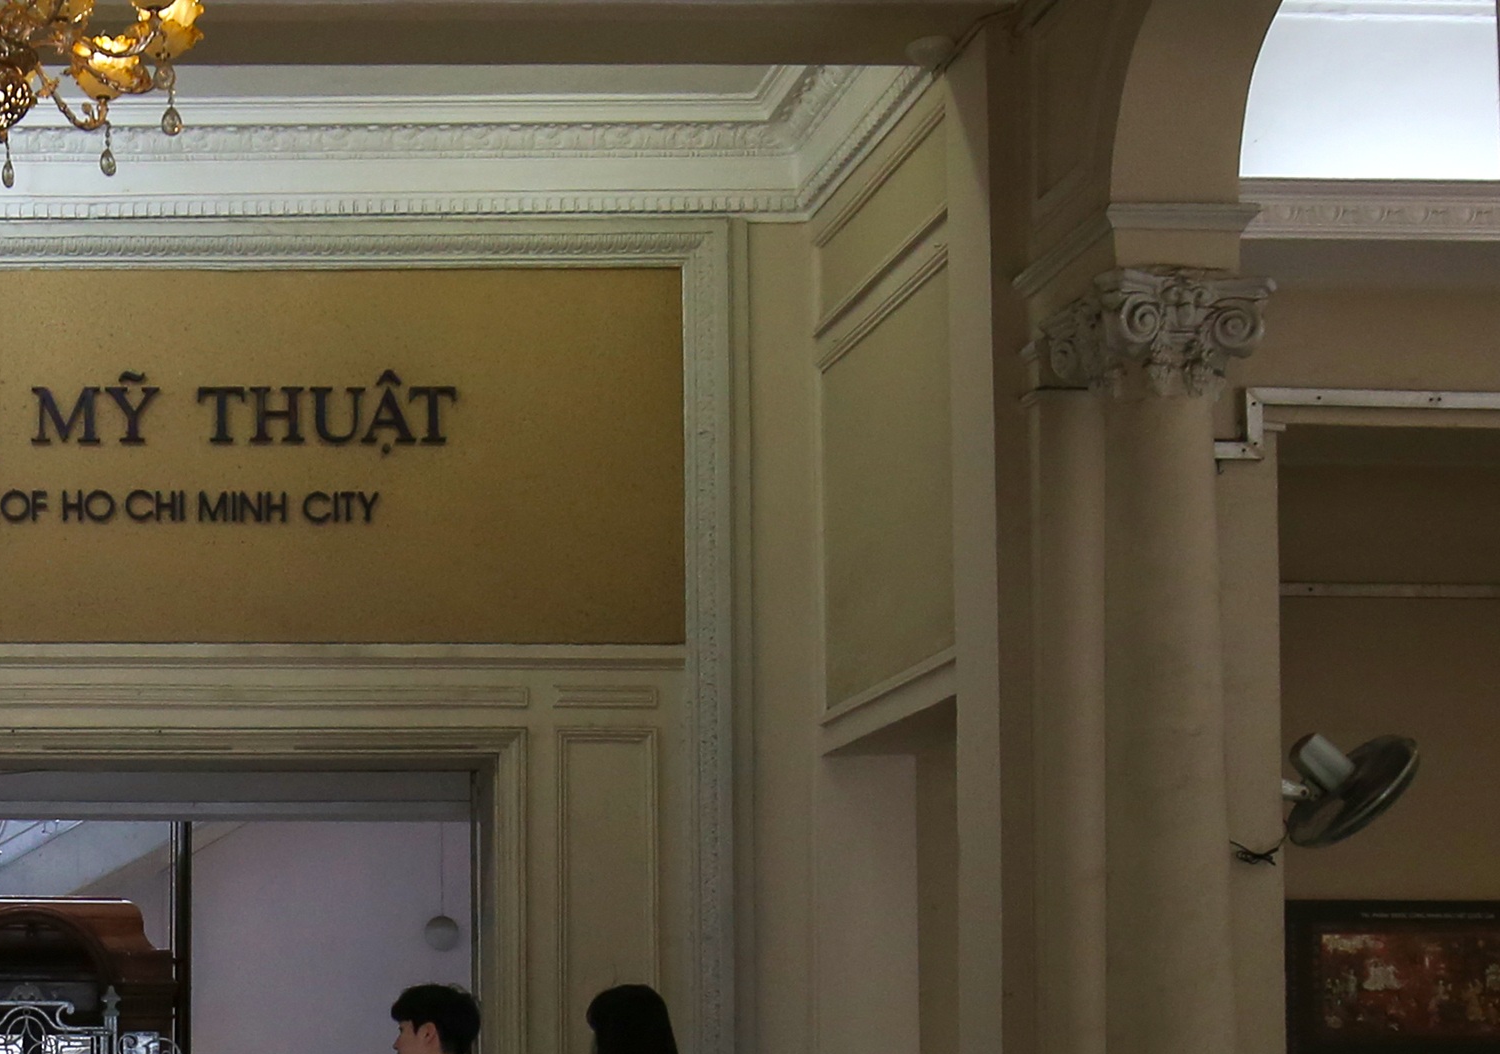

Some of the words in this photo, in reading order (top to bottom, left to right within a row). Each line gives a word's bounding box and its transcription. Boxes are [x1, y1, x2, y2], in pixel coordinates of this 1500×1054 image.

[30, 370, 161, 445] MỸ
[196, 369, 457, 454] THUẬT
[0, 489, 48, 523] OF
[62, 490, 116, 523] HO
[124, 490, 186, 523] CHI
[197, 490, 288, 523] MINH
[302, 490, 380, 523] CITY
